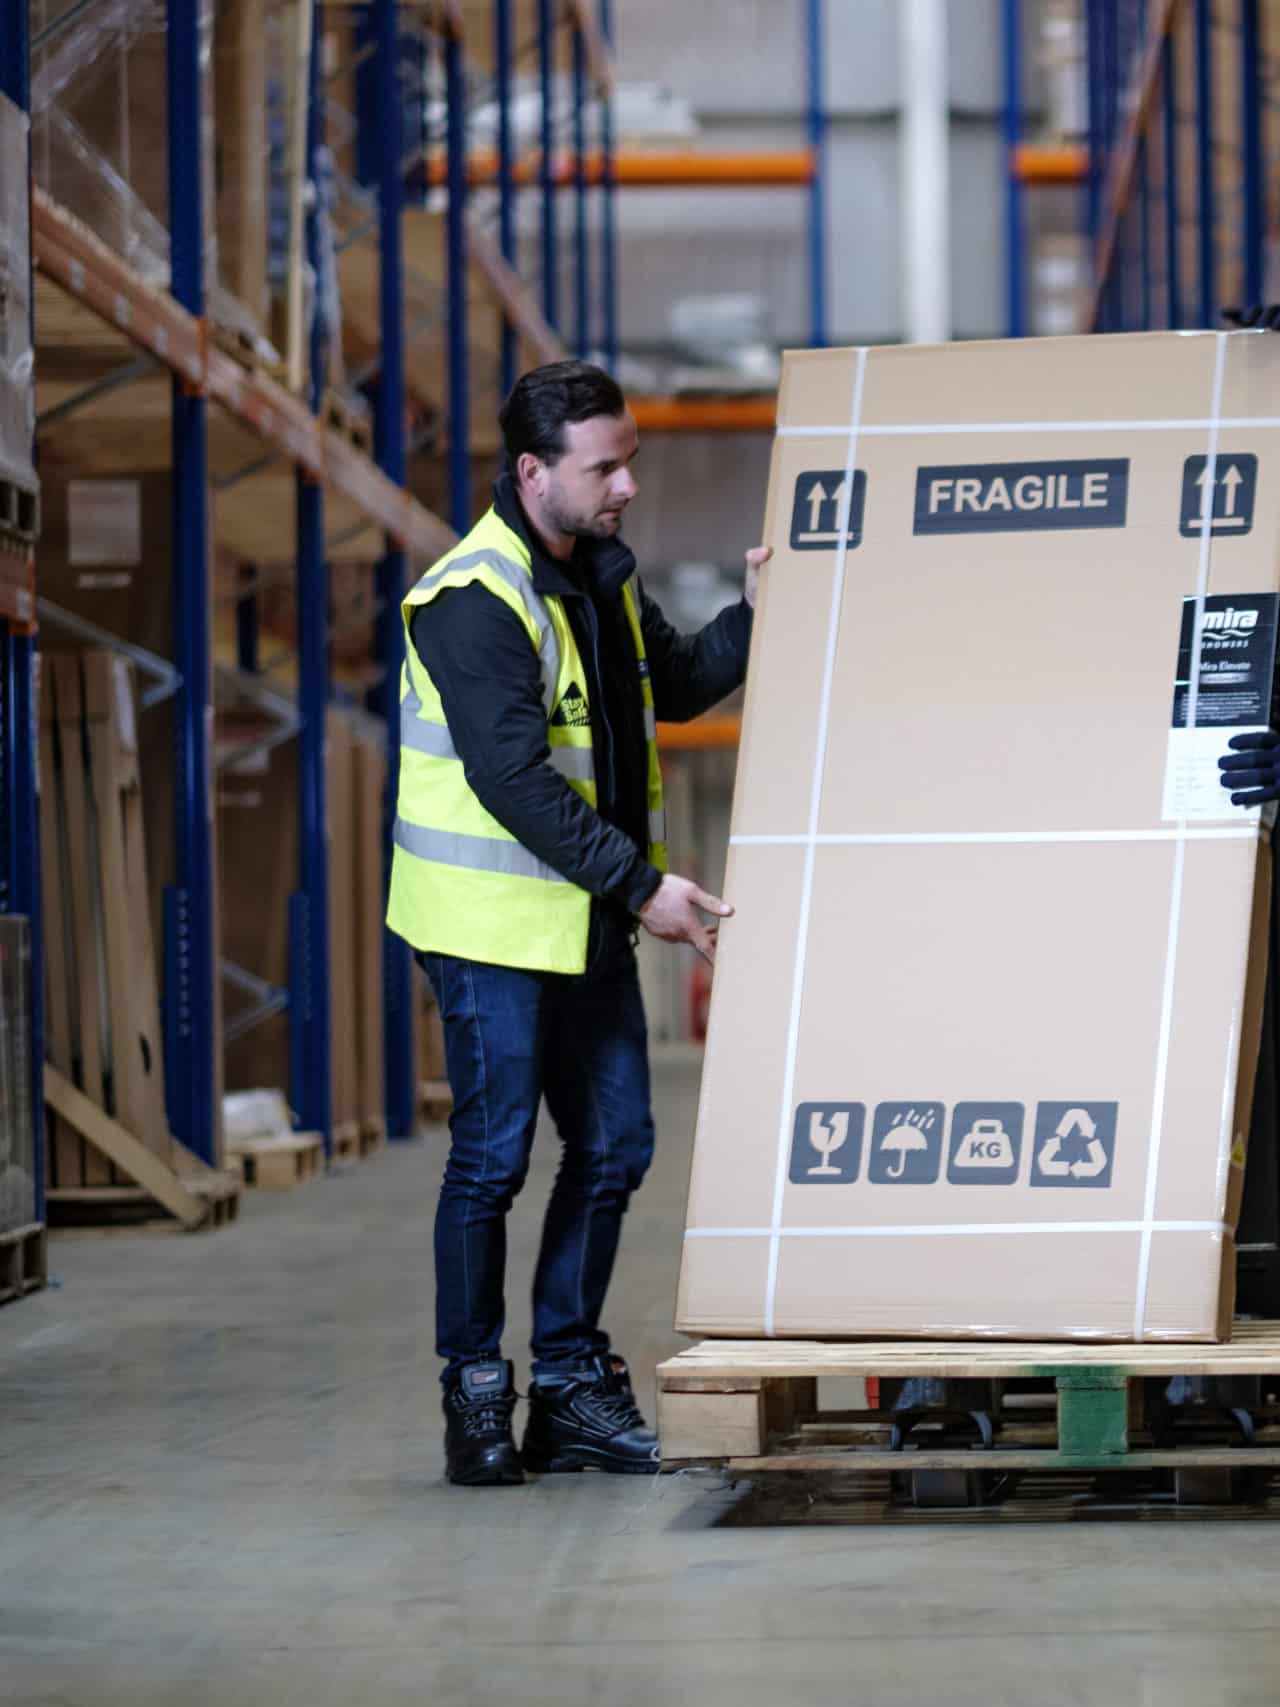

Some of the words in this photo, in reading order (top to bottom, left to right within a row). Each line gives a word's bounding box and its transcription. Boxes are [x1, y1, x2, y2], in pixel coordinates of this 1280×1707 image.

[929, 472, 1109, 514] FRAGILE
[1201, 607, 1259, 629] mira
[970, 1141, 1002, 1159] KG
